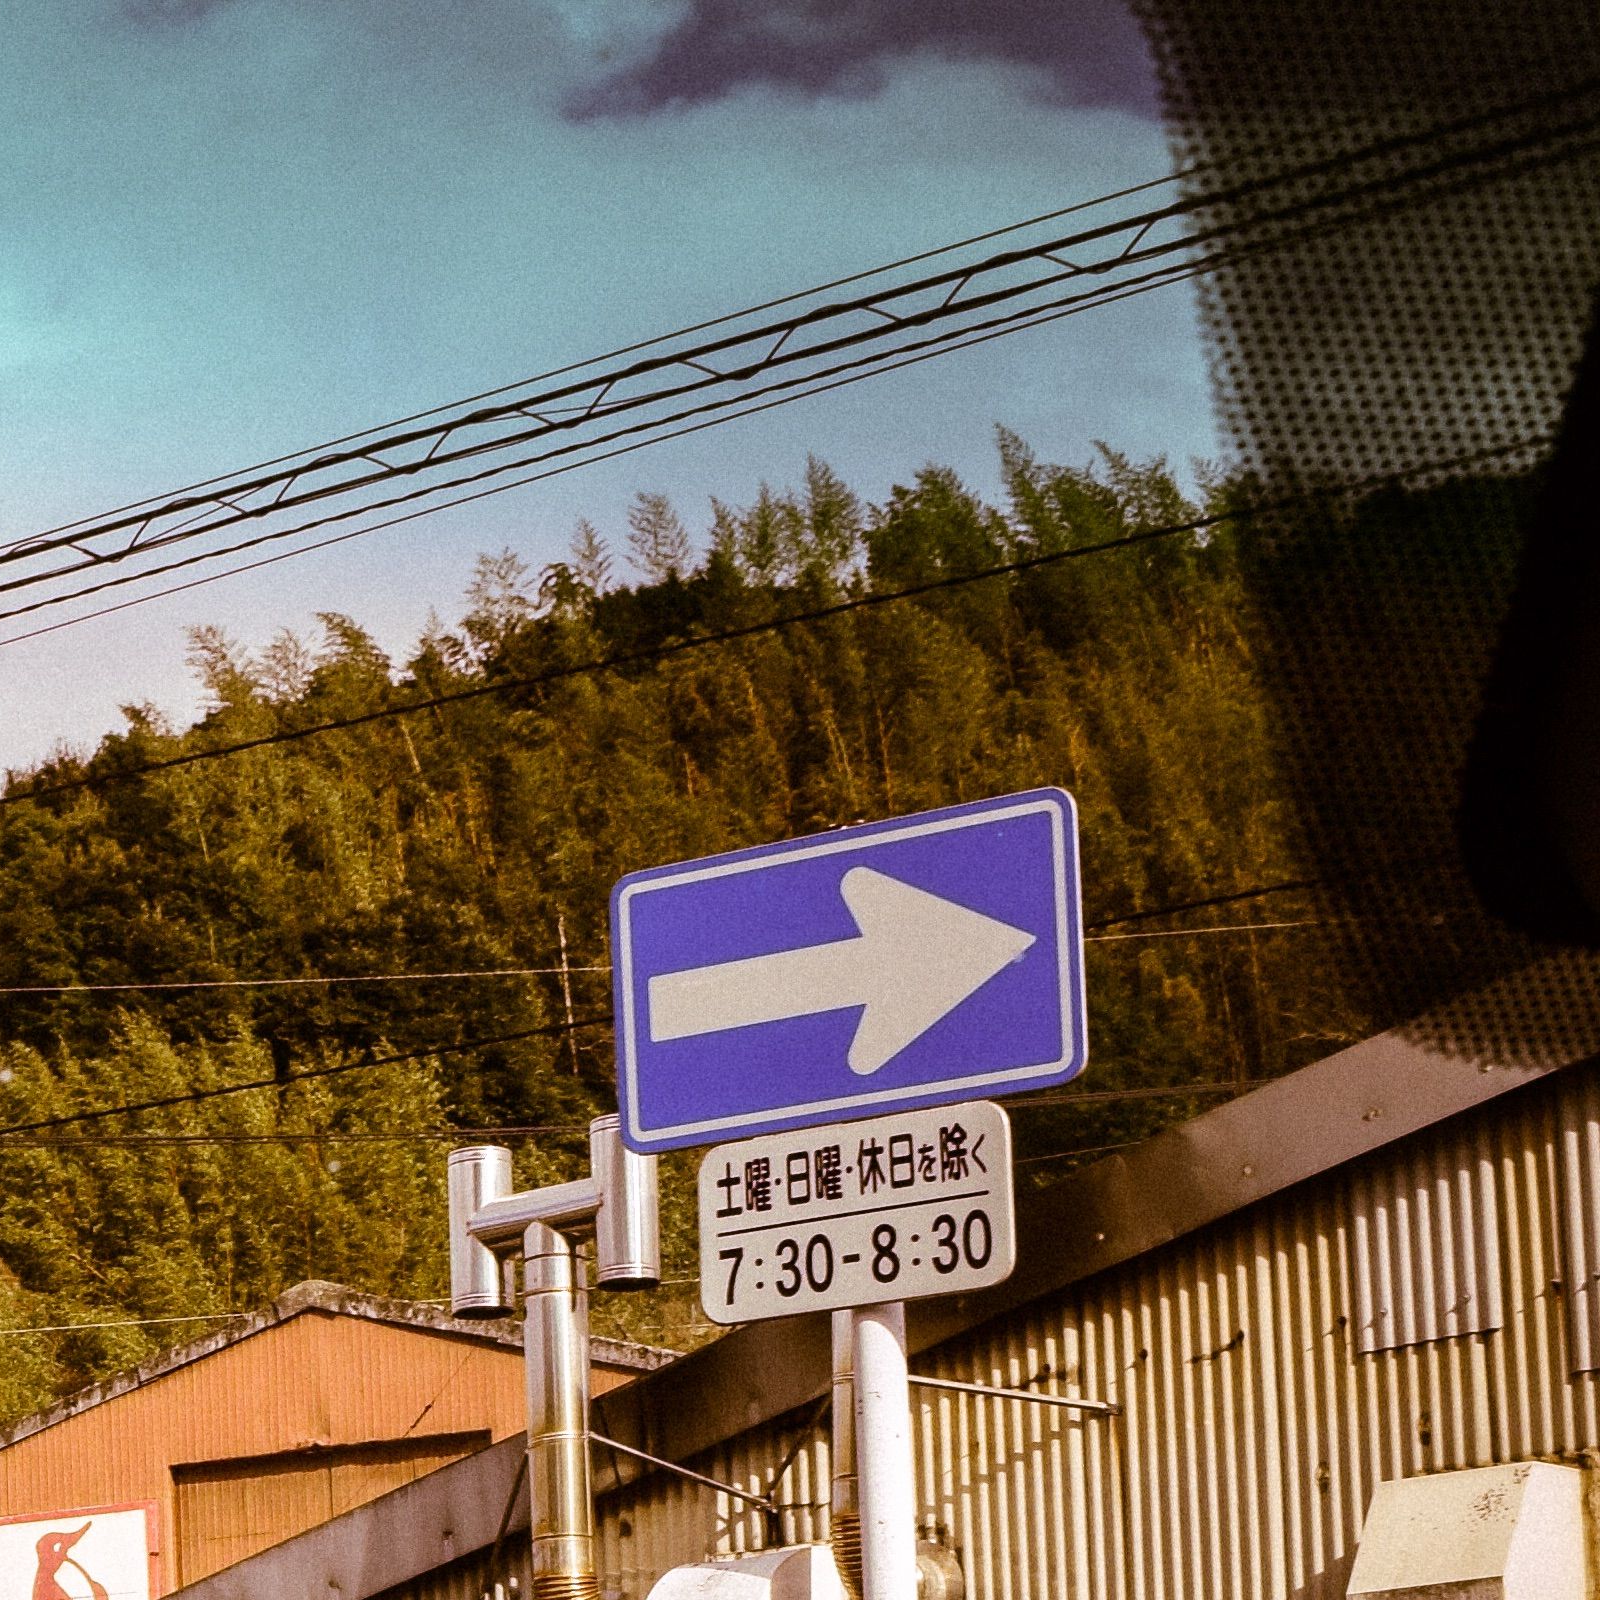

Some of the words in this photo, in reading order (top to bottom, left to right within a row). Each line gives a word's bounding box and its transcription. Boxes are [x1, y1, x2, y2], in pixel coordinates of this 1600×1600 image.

[715, 1121, 988, 1219] 土曜・日曜・休日を除く
